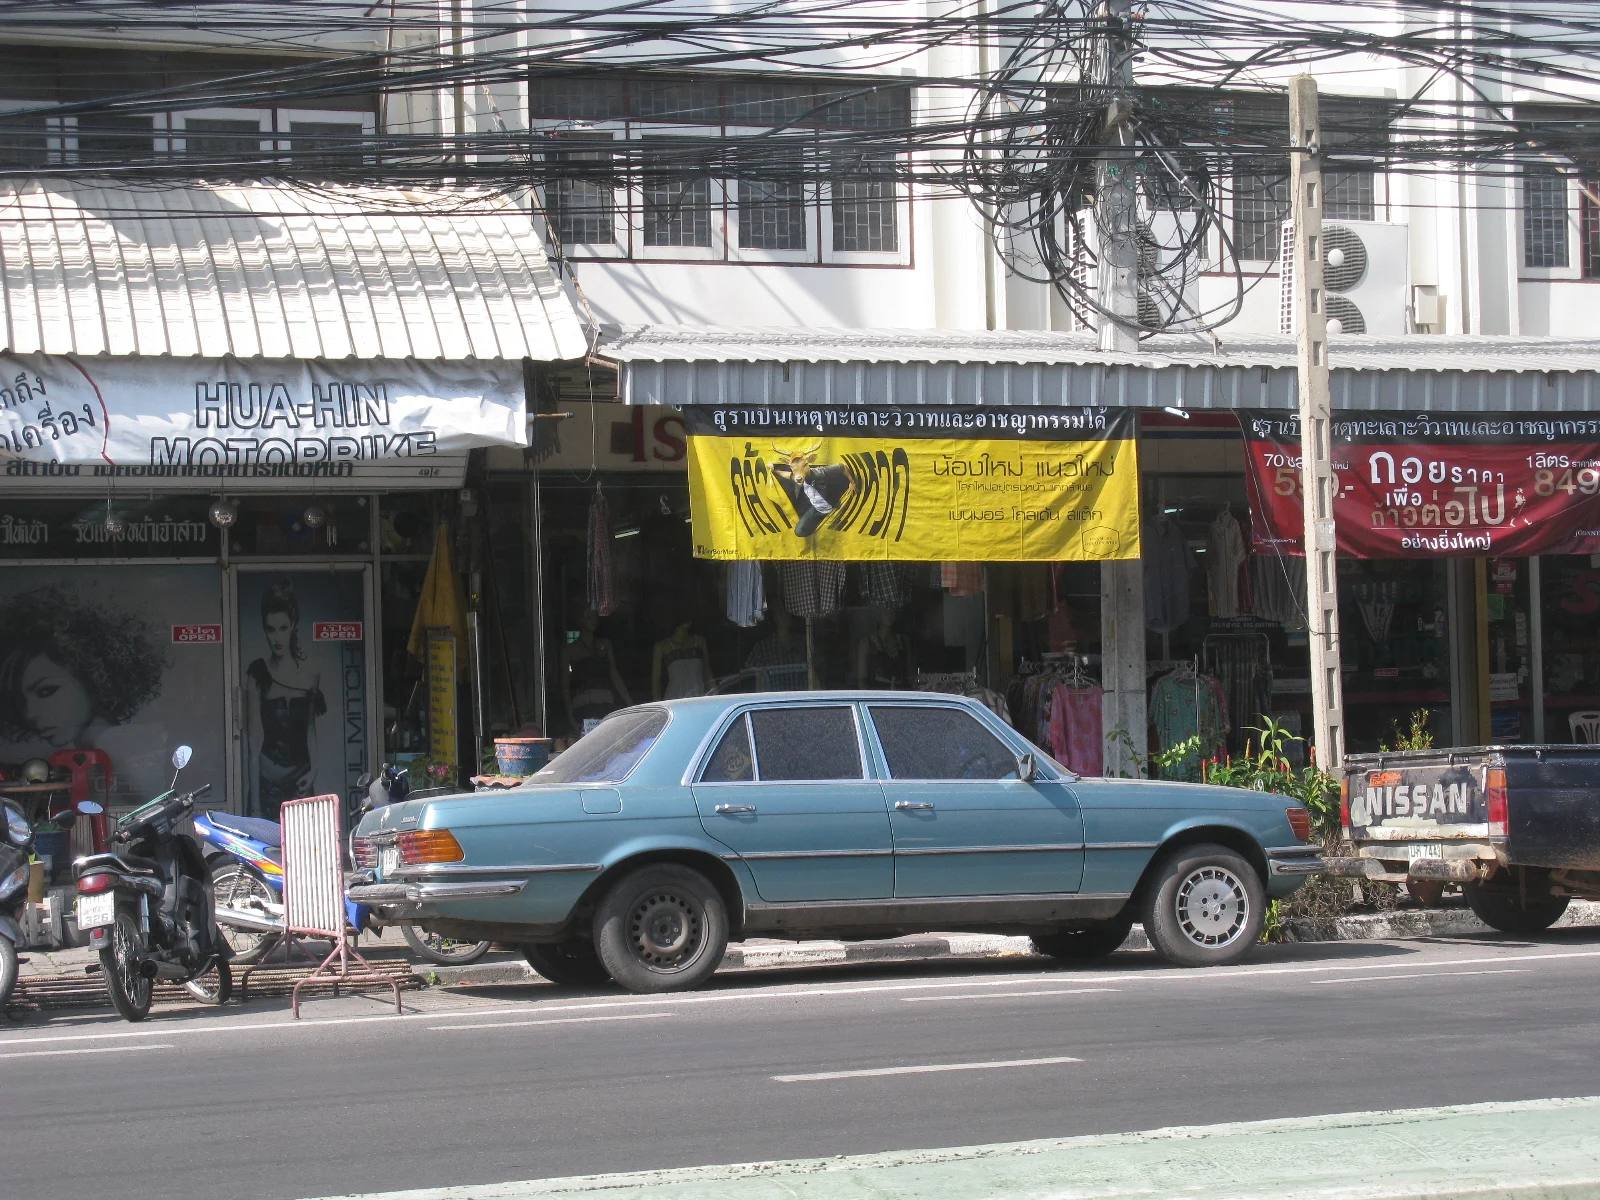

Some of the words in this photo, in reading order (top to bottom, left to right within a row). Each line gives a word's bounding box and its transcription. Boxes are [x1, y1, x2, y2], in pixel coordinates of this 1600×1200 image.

[0, 371, 46, 408] กถึง
[194, 382, 390, 429] HUA-HIN
[1386, 484, 1422, 507] เพื่อ
[178, 633, 217, 641] OPEN
[320, 631, 356, 639] OPEN
[1366, 783, 1468, 816] NISSAN
